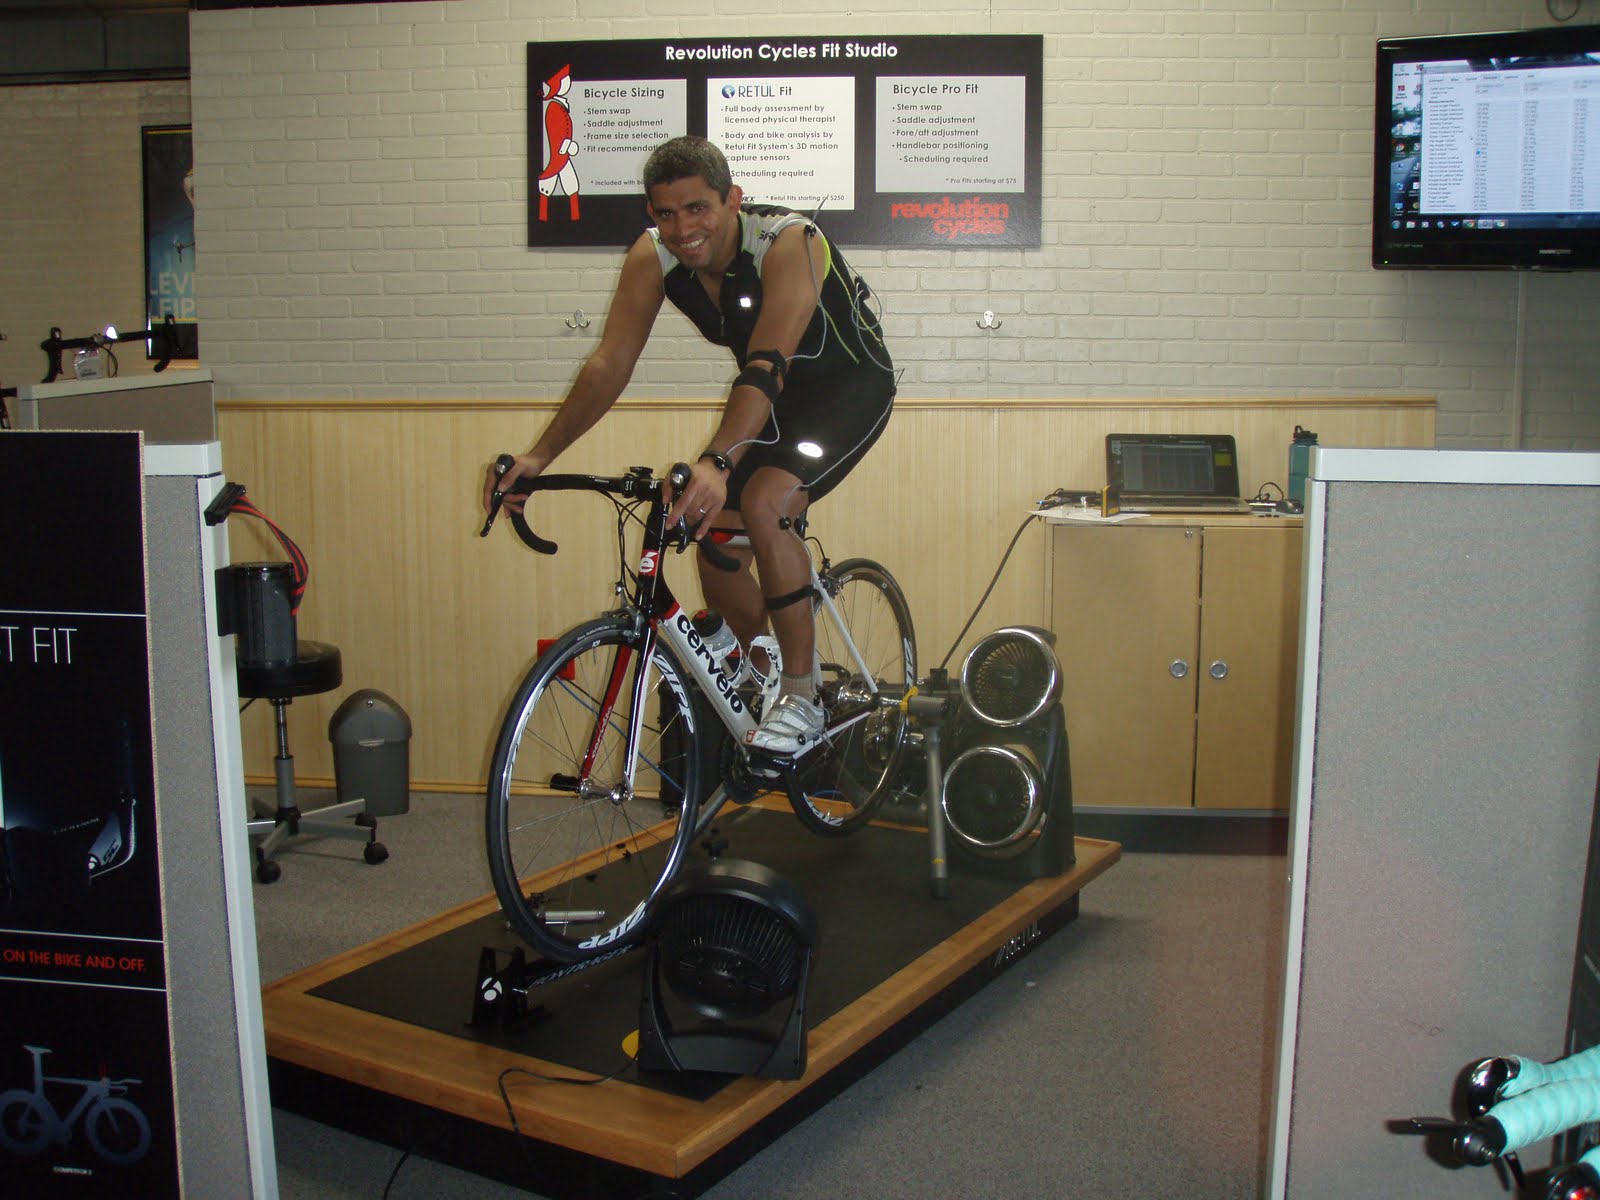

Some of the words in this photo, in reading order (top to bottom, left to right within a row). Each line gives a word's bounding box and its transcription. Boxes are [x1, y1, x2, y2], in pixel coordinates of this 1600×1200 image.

[666, 44, 753, 60] Revolution
[758, 44, 817, 62] Cycles
[822, 42, 841, 58] Fit
[845, 42, 898, 58] Studio
[584, 88, 628, 100] Bicycle
[631, 87, 664, 99] Sizing
[780, 86, 792, 96] Fit
[893, 84, 938, 96] Bicycle
[942, 84, 961, 94] Pro
[966, 84, 978, 94] Fit
[741, 105, 762, 113] body
[765, 104, 812, 112] assessment
[814, 104, 825, 112] by
[897, 103, 918, 111] Stem
[610, 108, 631, 116] swap
[618, 119, 663, 128] adjustment
[763, 116, 797, 124] physical
[800, 116, 836, 124] therapist
[897, 116, 926, 124] Saddle
[929, 116, 976, 125] adjustment
[587, 132, 612, 140] Frame
[632, 131, 669, 139] selection
[725, 132, 746, 140] Body
[787, 131, 820, 139] analysis
[932, 129, 979, 137] adjustment
[759, 143, 794, 151] System's
[797, 142, 807, 150] 3D
[810, 142, 839, 150] motion
[943, 142, 989, 150] positioning
[904, 155, 950, 163] Scheduling
[953, 156, 988, 164] required
[731, 170, 777, 178] Scheduling
[779, 170, 814, 178] required
[891, 196, 1008, 219] revolution
[933, 217, 1005, 240] cycles
[33, 627, 78, 664] FIT
[4, 950, 26, 964] ON
[30, 951, 52, 966] THE
[54, 952, 82, 968] BIKE
[86, 954, 117, 970] AND
